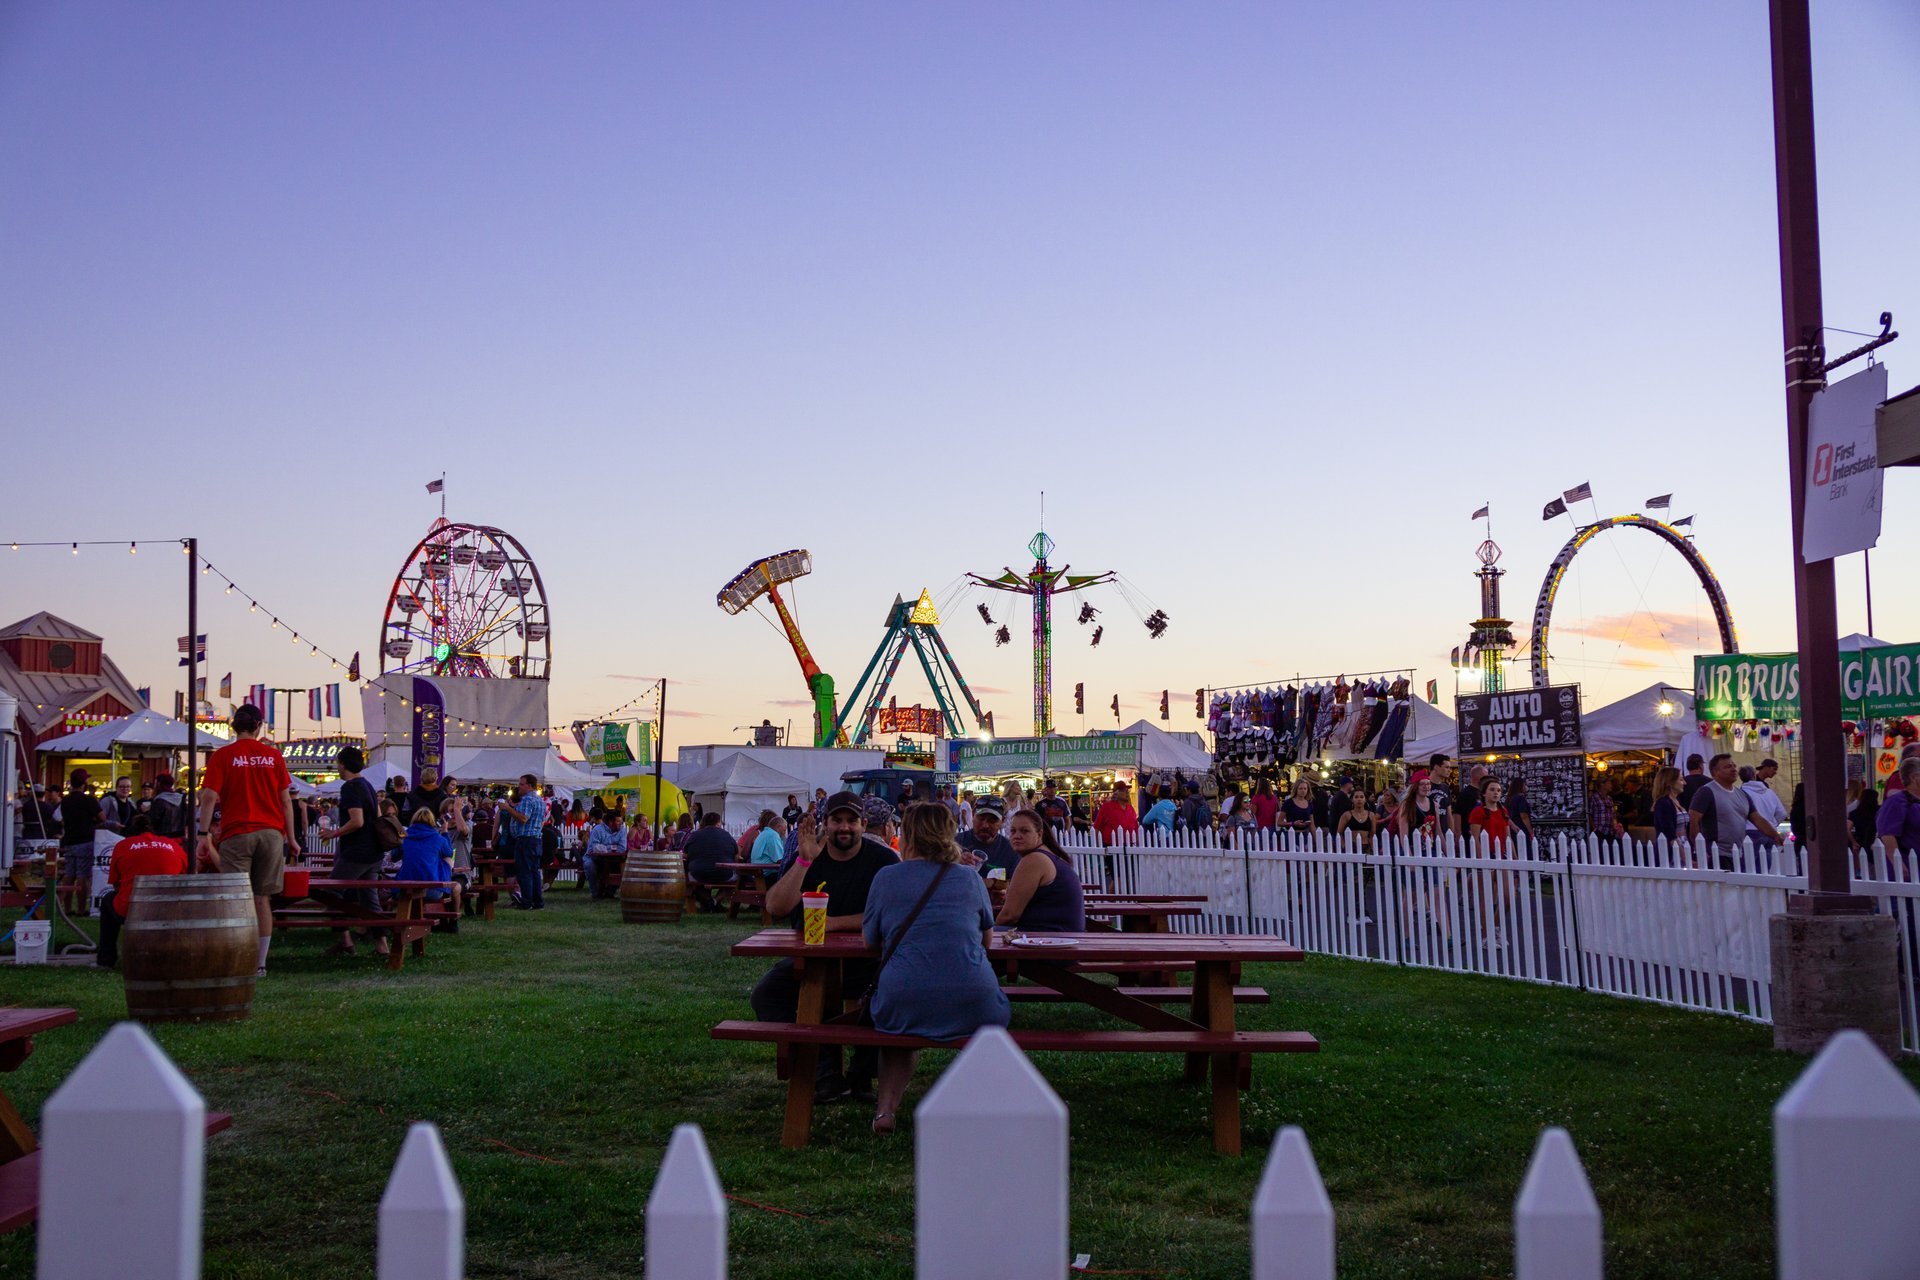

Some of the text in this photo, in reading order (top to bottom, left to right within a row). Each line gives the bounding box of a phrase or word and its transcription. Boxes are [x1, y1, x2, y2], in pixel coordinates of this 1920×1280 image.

[1835, 441, 1856, 463] First
[1832, 454, 1876, 482] Interstate
[1830, 481, 1849, 501] Bank
[1488, 692, 1542, 720] AUTO
[1480, 719, 1556, 748] DECALS
[606, 742, 624, 752] REAL
[963, 742, 1038, 758] HAND CRAFTED
[1052, 738, 1134, 751] HAND CRAFTED
[232, 756, 275, 767] ALL STAR
[130, 841, 174, 851] ALL STAR
